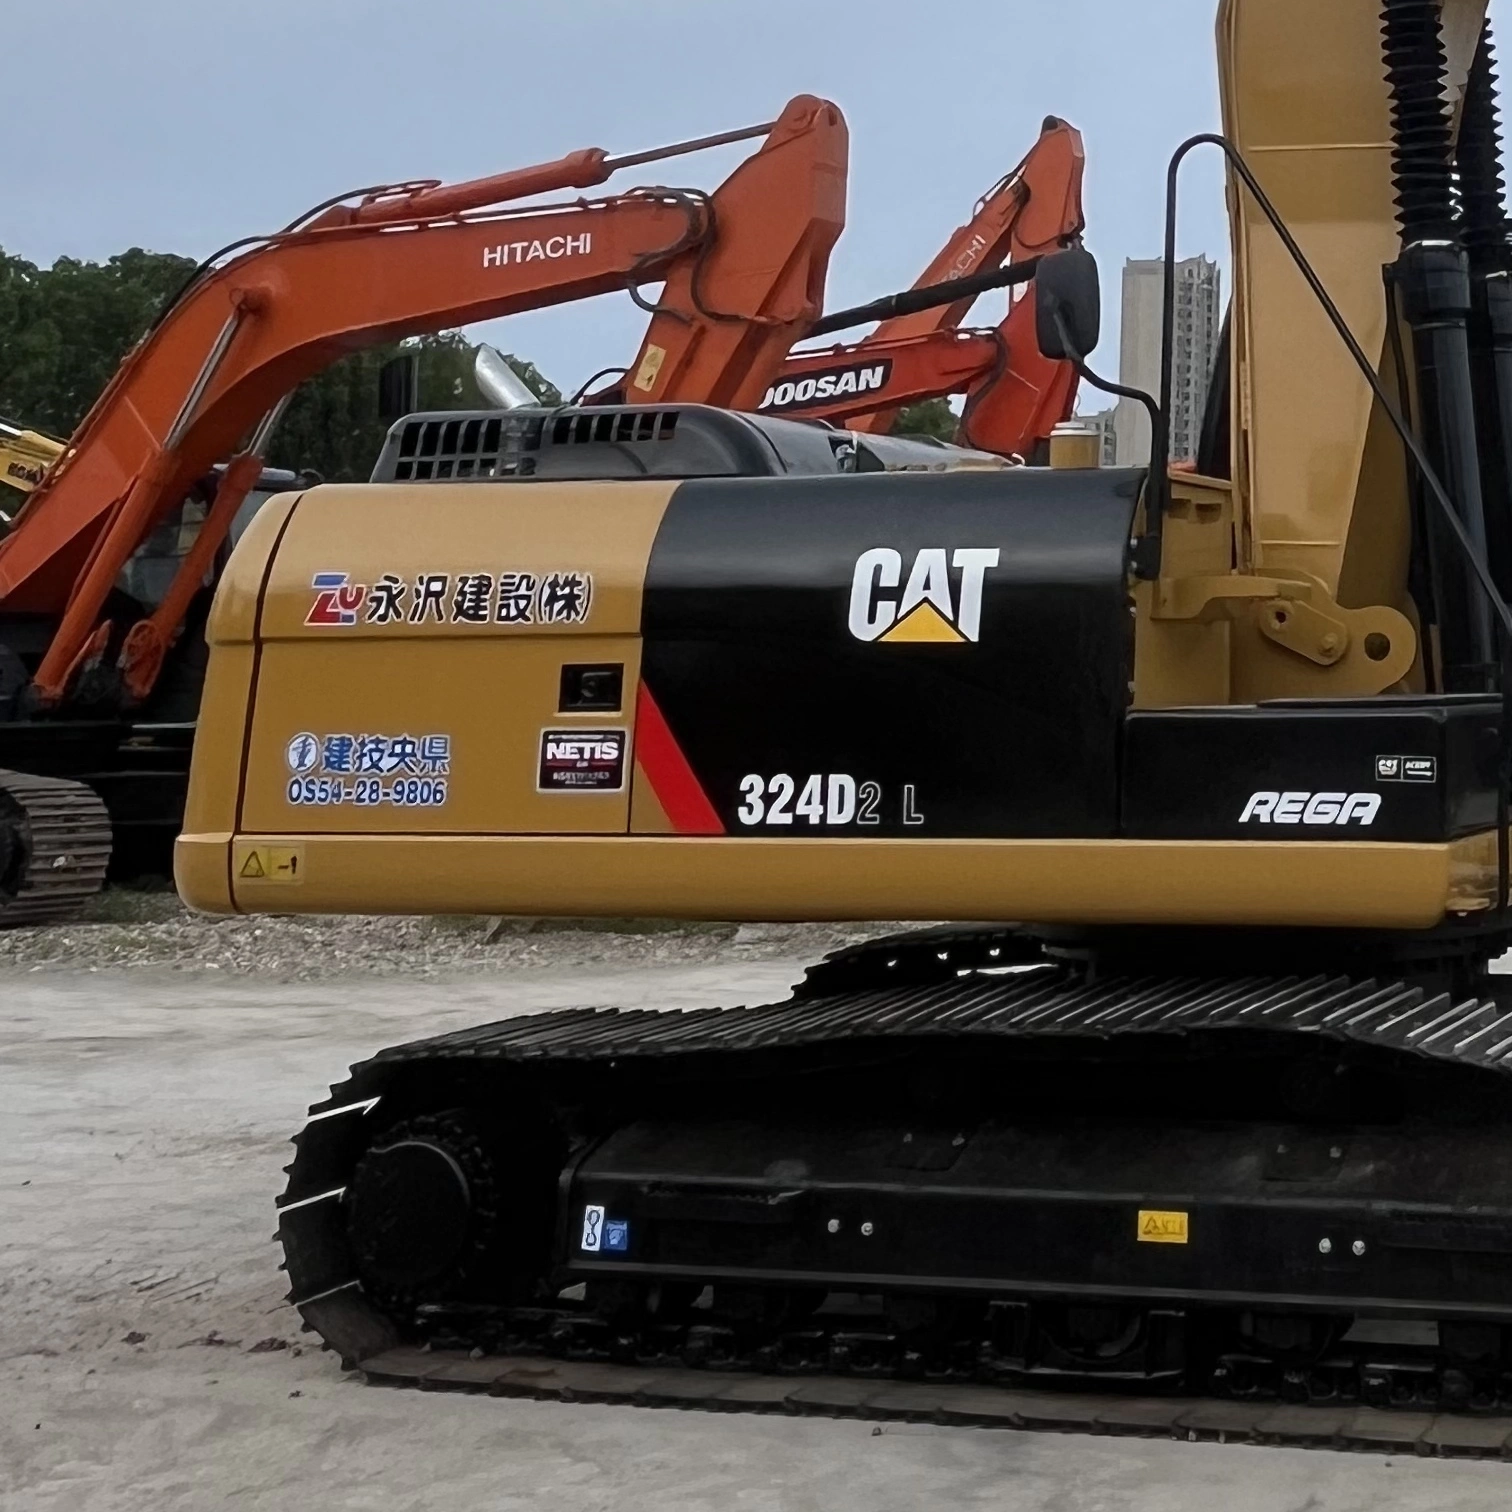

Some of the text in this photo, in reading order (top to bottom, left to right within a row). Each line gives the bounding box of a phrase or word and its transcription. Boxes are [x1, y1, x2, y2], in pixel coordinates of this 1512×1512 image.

[483, 232, 591, 268] HITACHI
[366, 572, 593, 625] 永沢建設(株)
[848, 547, 1001, 643] CAT
[546, 741, 620, 760] NETIS
[737, 773, 925, 826] 324D2 L
[1238, 791, 1382, 825] REGA
